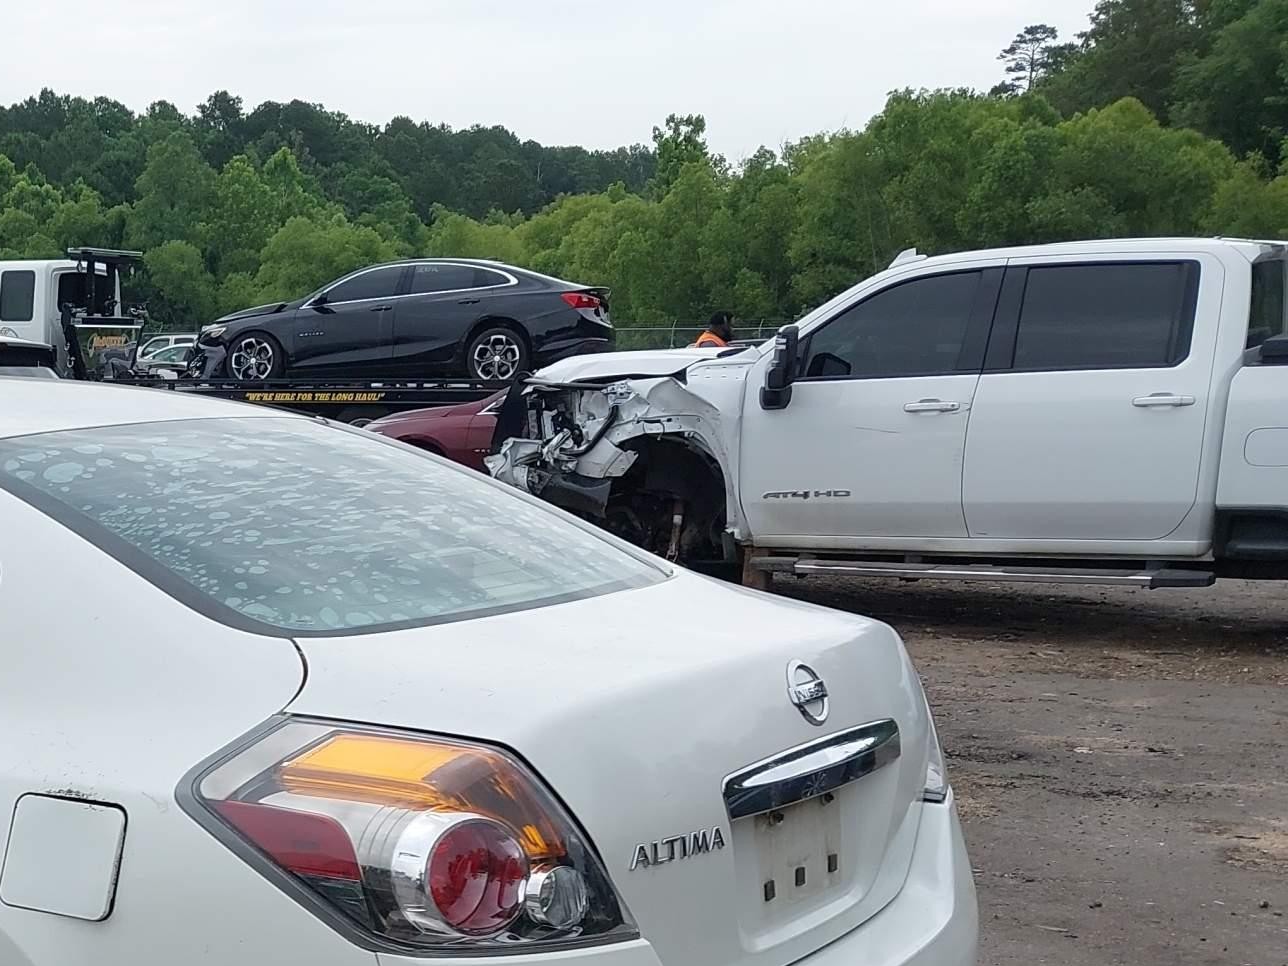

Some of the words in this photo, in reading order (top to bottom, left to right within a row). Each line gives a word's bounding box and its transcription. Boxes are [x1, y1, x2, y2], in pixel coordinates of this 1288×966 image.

[274, 392, 295, 400] HERE
[296, 392, 313, 400] FOR
[314, 392, 330, 400] THE
[331, 392, 354, 400] LONG
[762, 489, 810, 499] AT4
[814, 488, 851, 497] HD
[629, 826, 725, 871] ALTIMA
